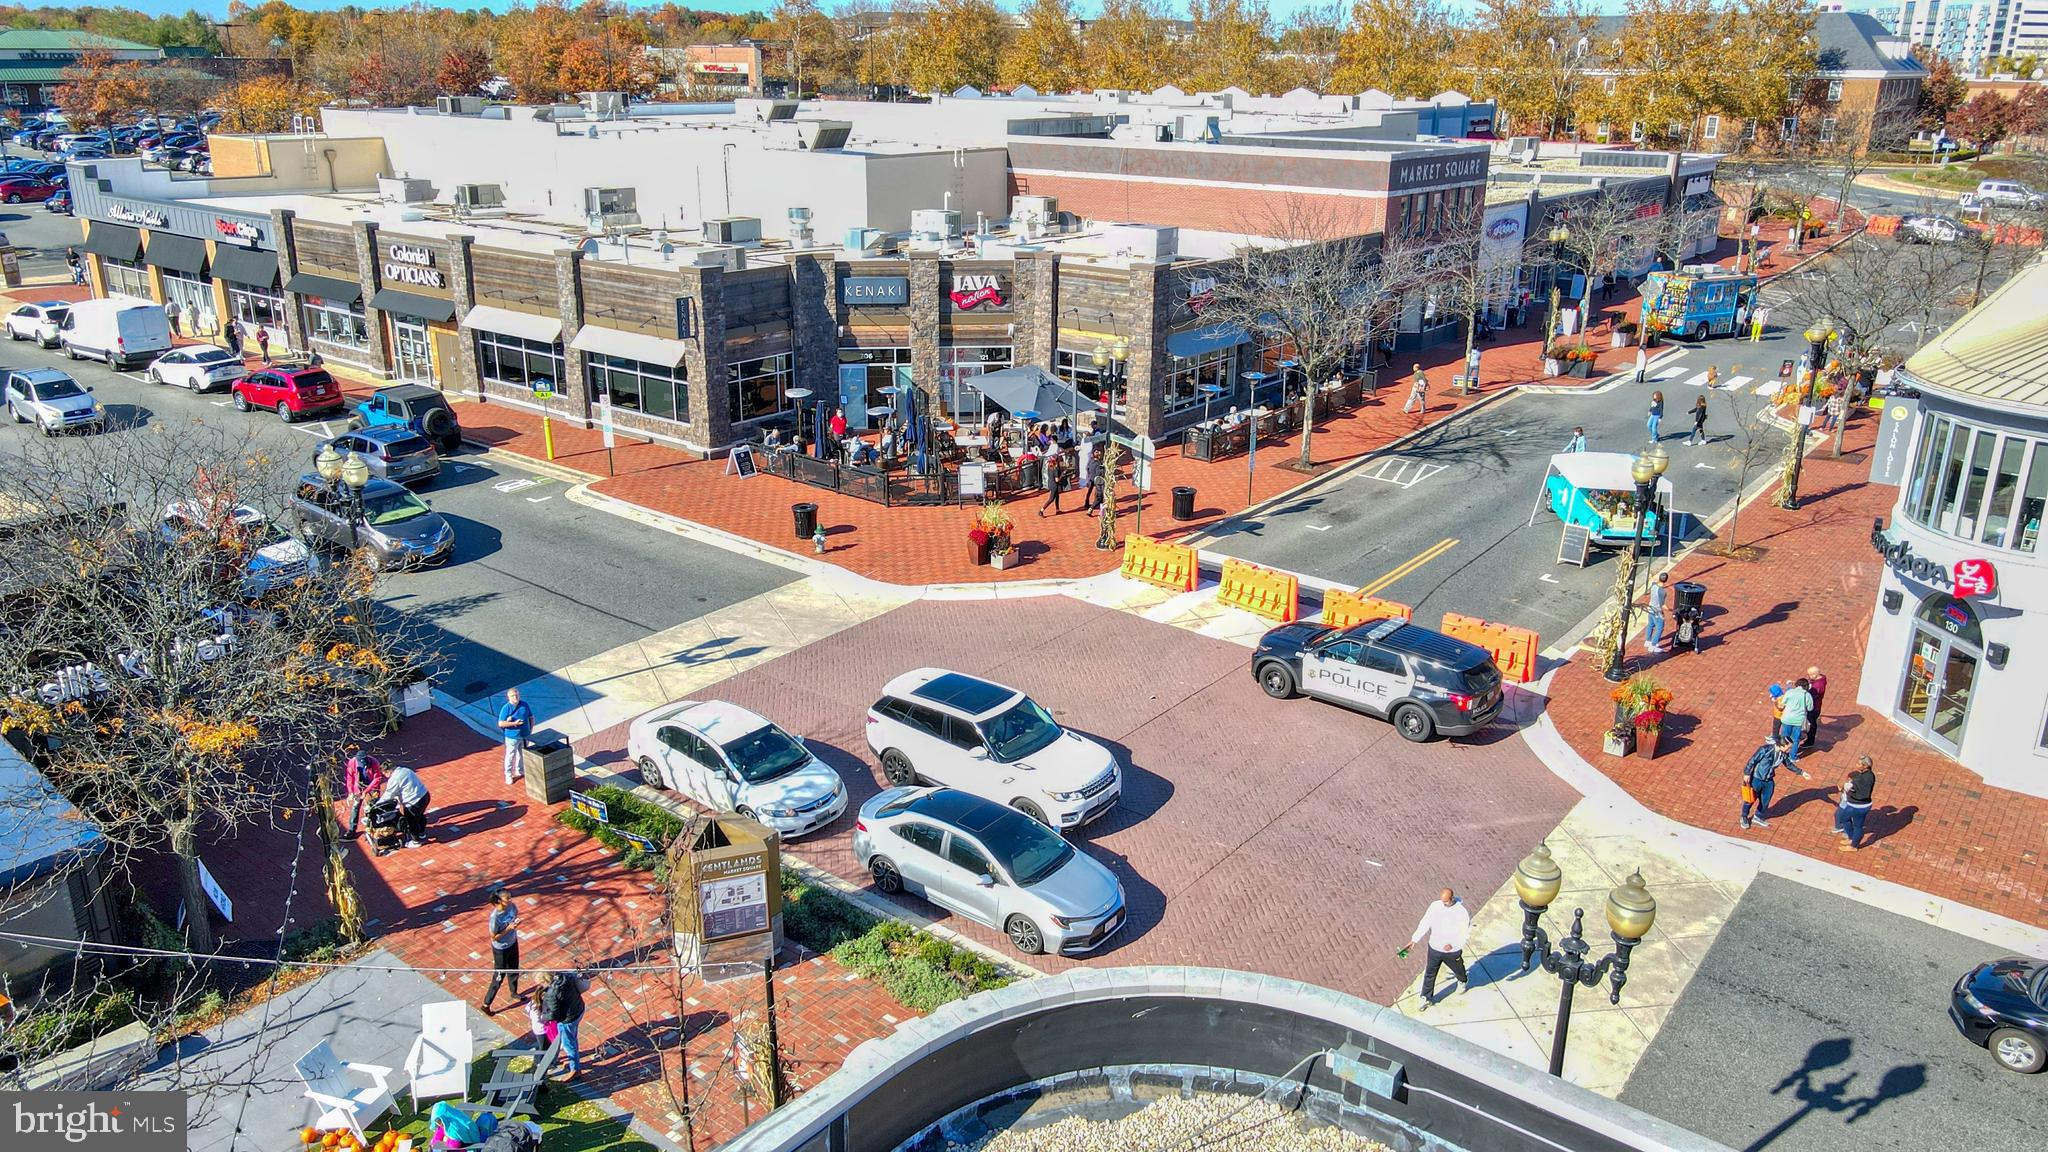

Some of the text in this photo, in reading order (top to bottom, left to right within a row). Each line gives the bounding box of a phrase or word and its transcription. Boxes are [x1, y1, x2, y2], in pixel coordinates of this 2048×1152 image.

[1400, 159, 1481, 184] MARKET SQUARE
[390, 245, 430, 265] Colonial
[385, 264, 441, 287] OPTICIANS
[952, 275, 1001, 293] JAVA
[845, 285, 902, 298] KENAKI
[961, 289, 991, 305] nation
[1945, 620, 1959, 634] 130
[1319, 669, 1388, 697] POLICE
[1472, 704, 1488, 715] POLICE
